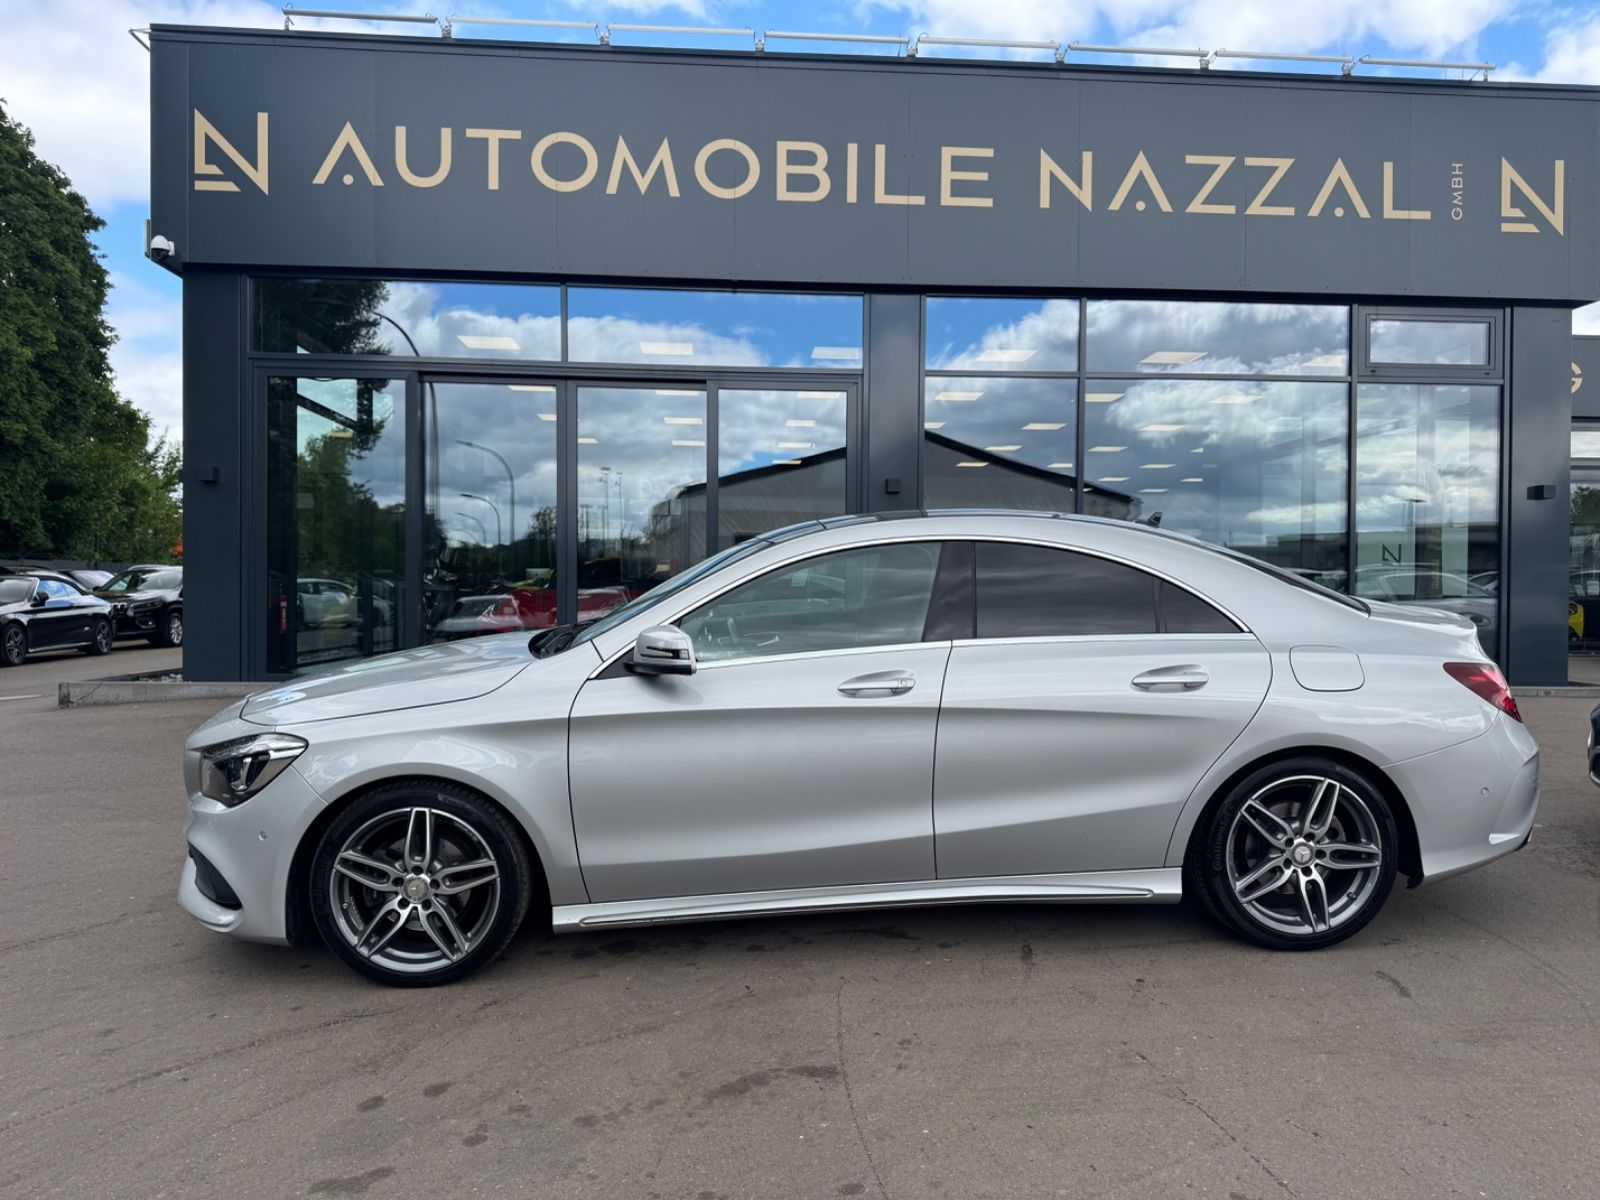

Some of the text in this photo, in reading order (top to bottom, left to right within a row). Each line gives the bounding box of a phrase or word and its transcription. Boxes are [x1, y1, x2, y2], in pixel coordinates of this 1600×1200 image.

[312, 121, 1431, 220] AUTOMOBILE NAZZAL
[1451, 163, 1463, 221] GMBH
